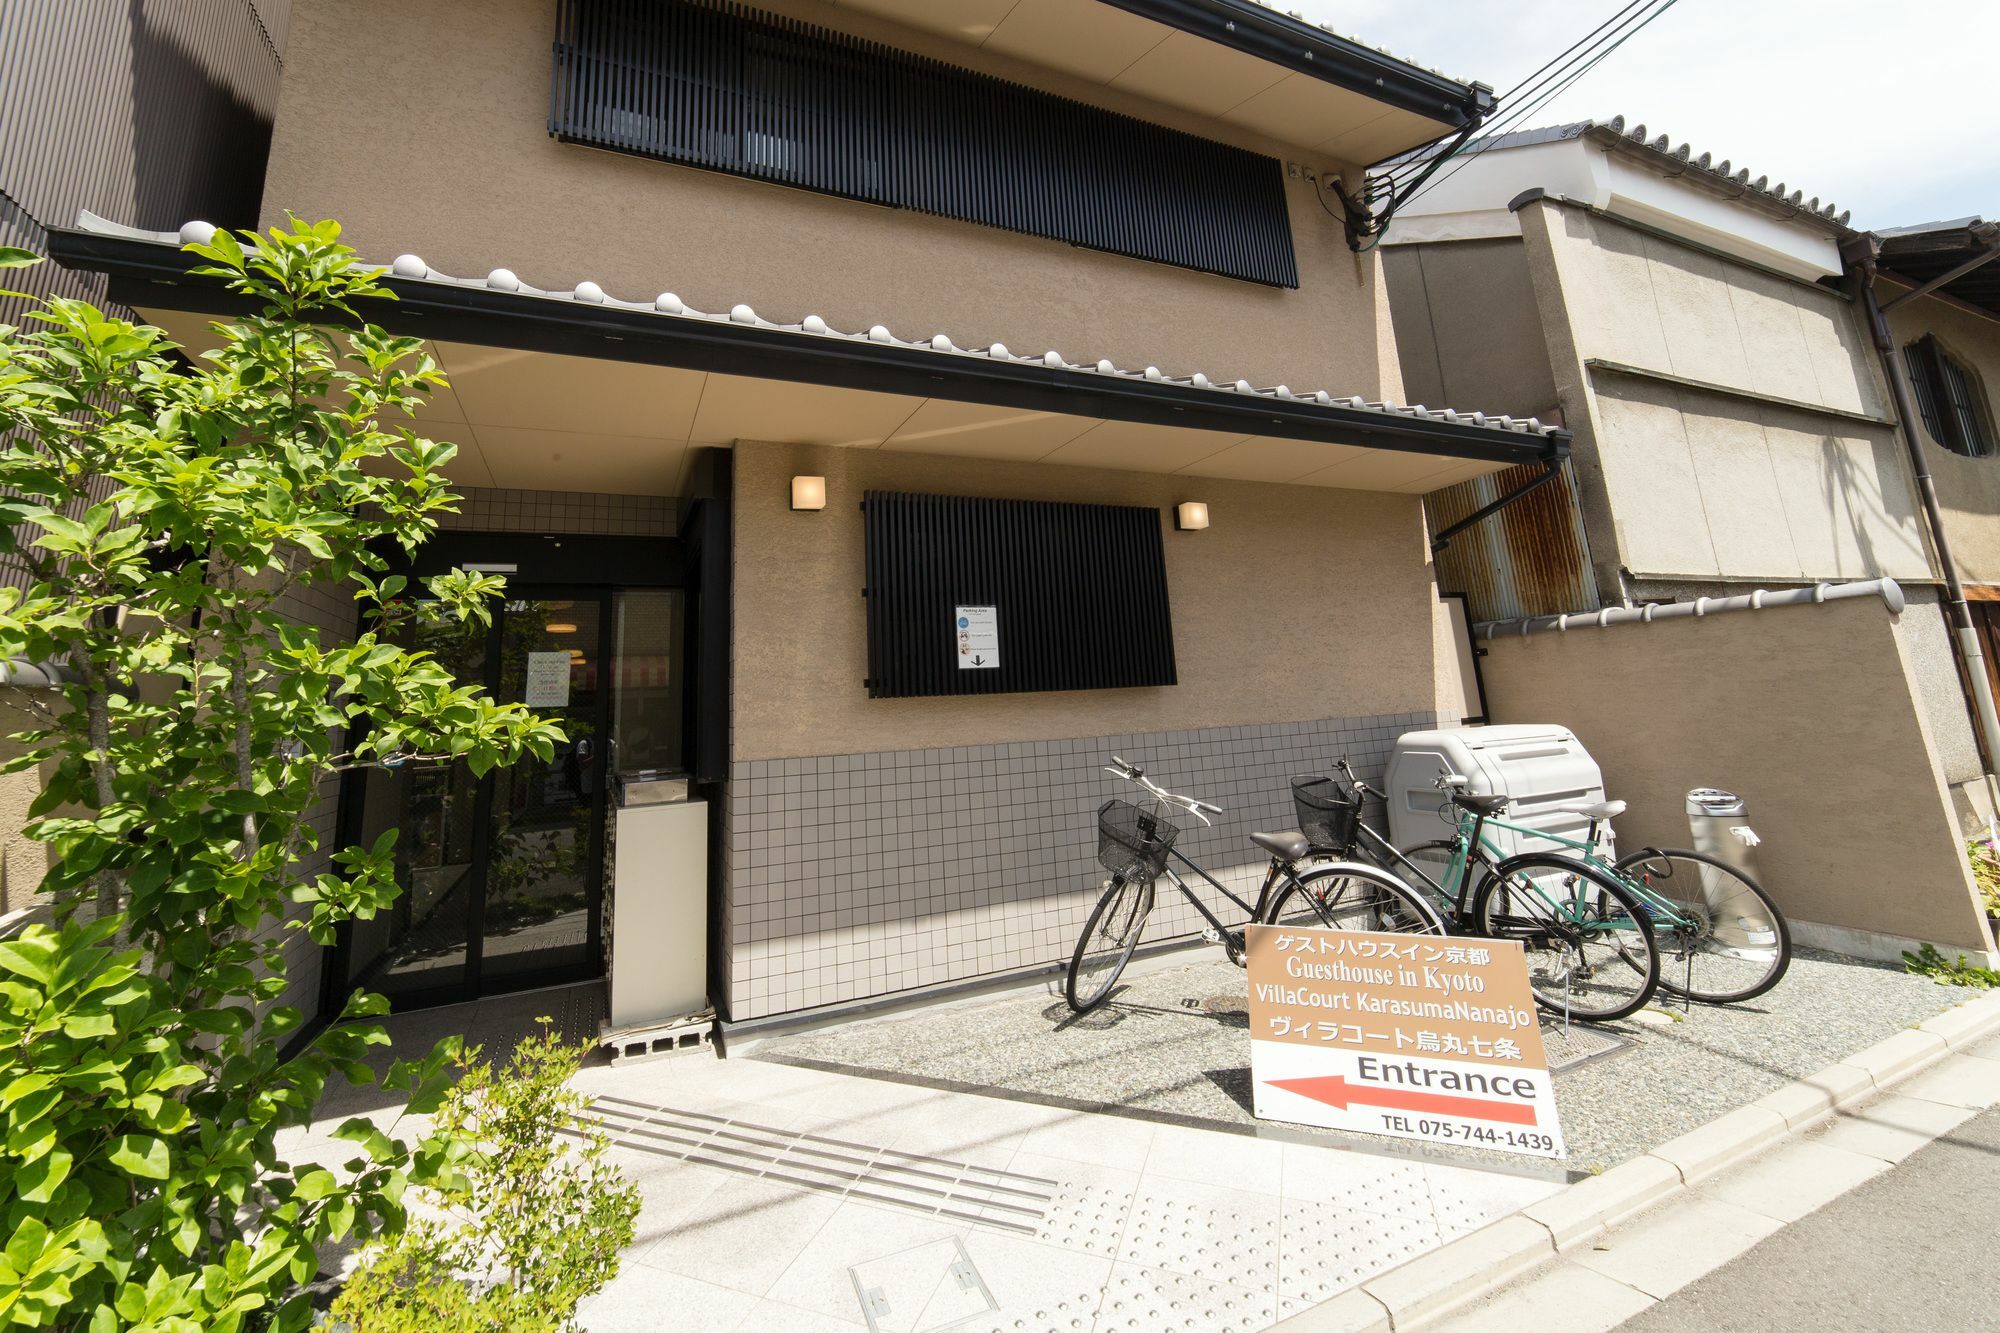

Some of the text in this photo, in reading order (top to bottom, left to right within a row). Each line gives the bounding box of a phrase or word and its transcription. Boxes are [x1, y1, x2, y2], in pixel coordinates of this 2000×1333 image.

[1274, 933, 1490, 966] ゲストハウスイン京都
[1286, 955, 1485, 996] Guesthouse in Kyoto
[1255, 983, 1531, 1030] VillaCourt KarasumaNanajo
[1269, 1015, 1523, 1061] ヴィラコート烏丸七条
[1357, 1056, 1536, 1099] Entrance
[1381, 1114, 1553, 1151] TEL 075-744-1439
